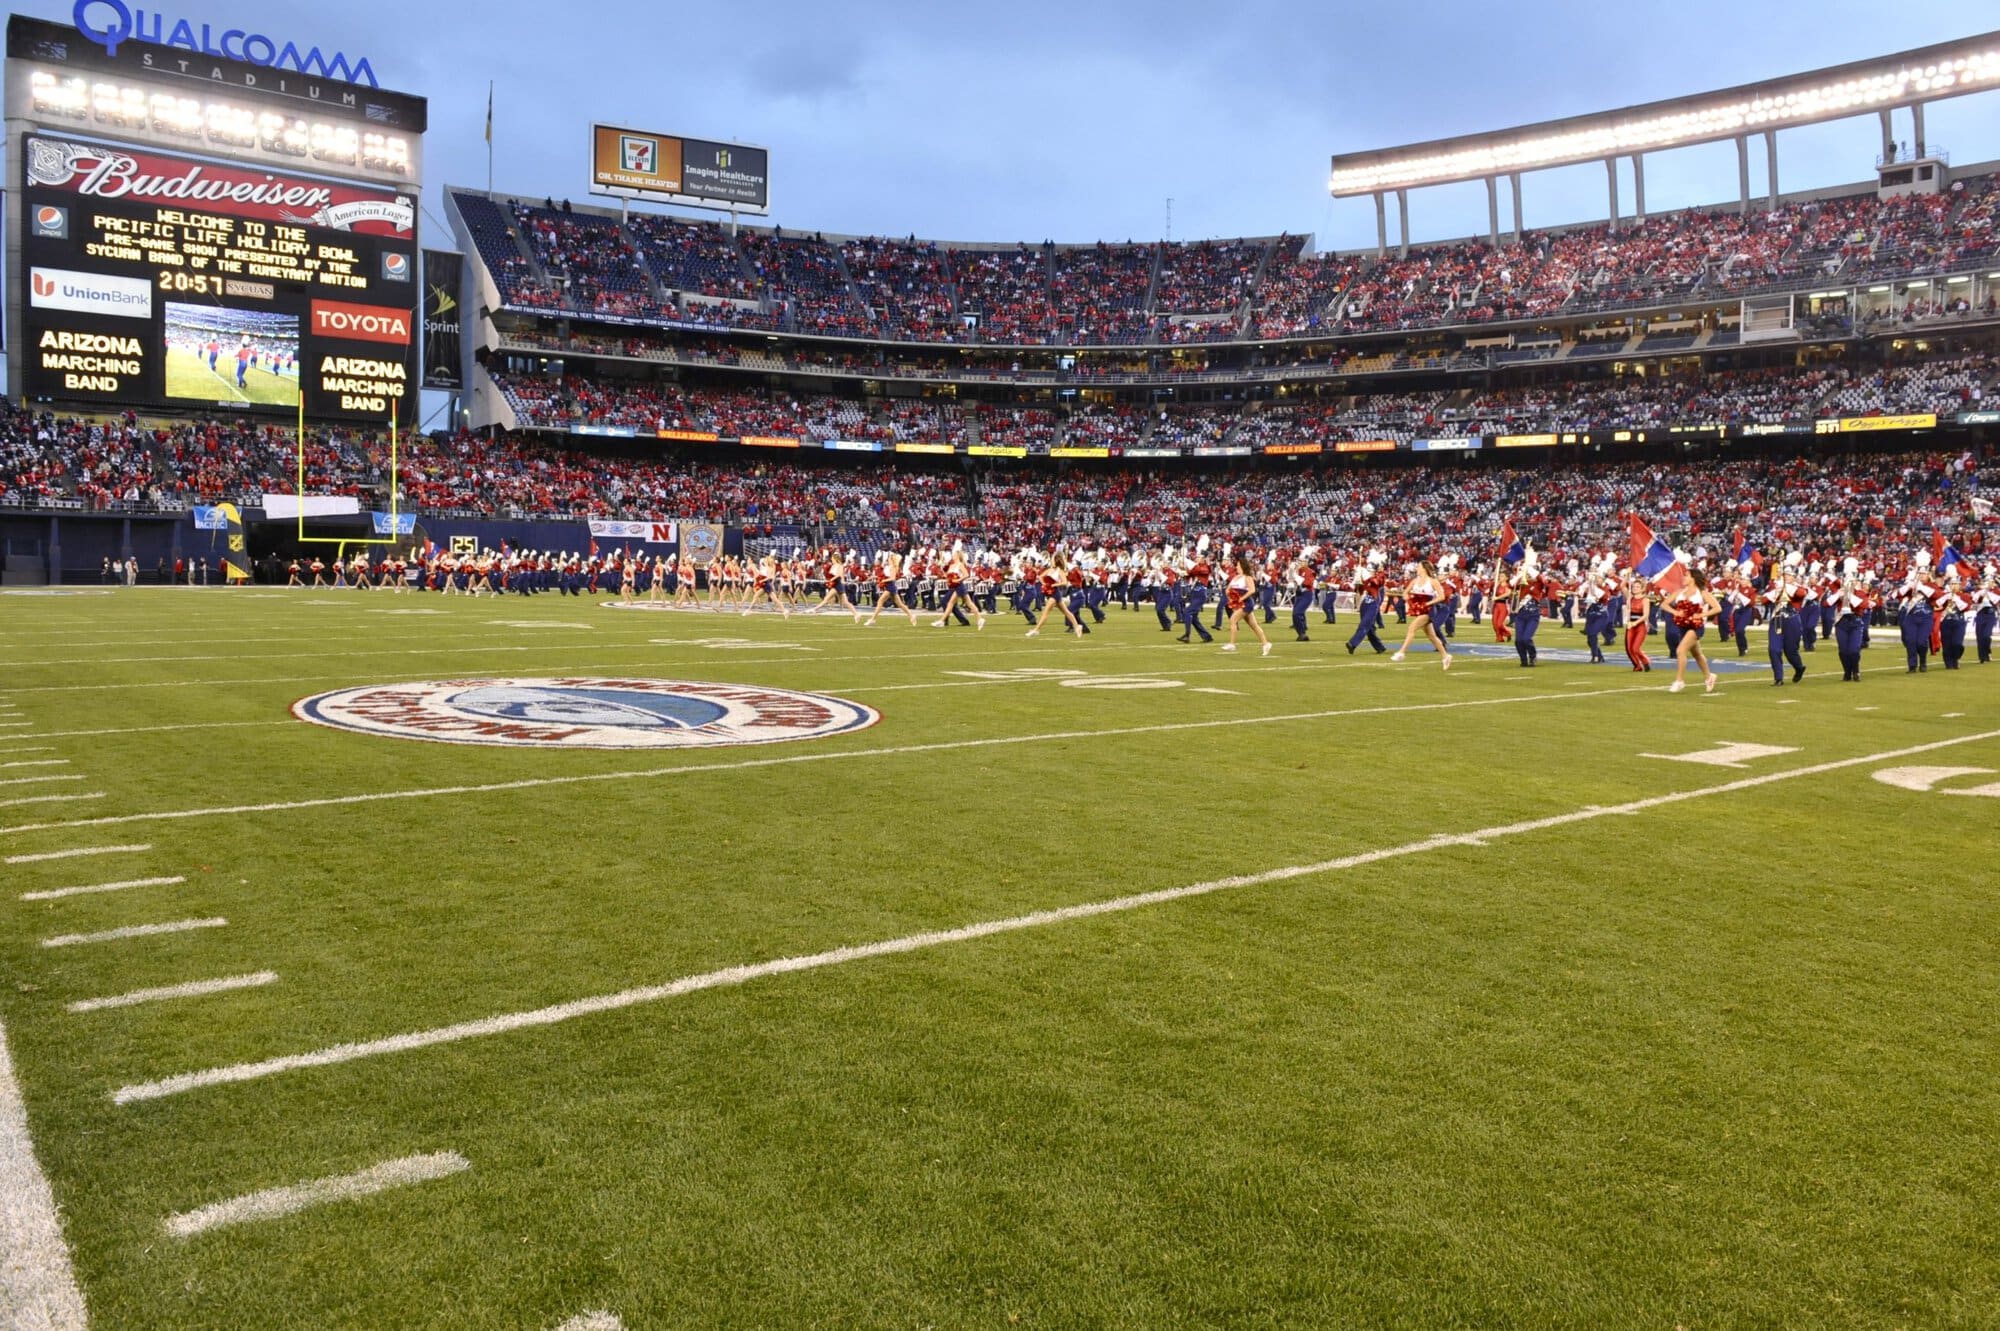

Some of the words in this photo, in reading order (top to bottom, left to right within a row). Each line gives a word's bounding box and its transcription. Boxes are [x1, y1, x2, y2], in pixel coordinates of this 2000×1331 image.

[73, 0, 379, 88] QUALCOMM
[143, 53, 356, 105] STADIUM
[65, 155, 331, 207] Budweiser
[614, 174, 643, 185] THANK
[685, 164, 719, 179] Imaging
[720, 169, 763, 183] Healthcare
[689, 182, 703, 190] Your
[705, 184, 727, 193] Partner
[737, 189, 756, 197] Health
[334, 208, 379, 222] American
[382, 207, 410, 221] Lager
[157, 209, 234, 232] WELCOME
[243, 222, 266, 236] TO
[274, 226, 306, 242] THE
[93, 215, 175, 238] PACIFIC
[183, 227, 229, 246] LIFE
[237, 234, 310, 256] HOLIDAY
[318, 245, 359, 263] BOWL
[104, 232, 176, 252] PRE-GAME
[182, 243, 218, 257] SHOW
[224, 248, 298, 267] PRESENTED
[304, 258, 321, 270] BY
[328, 262, 352, 274] THE
[86, 243, 141, 261] SYCUAN
[148, 251, 184, 266] BAND
[191, 256, 209, 269] OF
[216, 259, 242, 273] THE
[319, 271, 367, 289] NATION
[159, 271, 223, 296] 20:57
[227, 282, 273, 296] SYCUAN
[63, 285, 149, 305] UnionBank
[316, 310, 407, 336] TOYOTA
[424, 318, 460, 334] Sprint
[39, 330, 143, 357] ARIZONA
[42, 353, 141, 376] MARCHING
[320, 356, 407, 380] ARIZONA
[65, 374, 118, 392] BAND
[322, 377, 404, 397] MARCHING
[341, 395, 386, 412] BAND
[659, 429, 685, 438] WELLS
[687, 431, 717, 440] FARGO
[652, 524, 670, 540] N
[454, 538, 473, 553] 25
